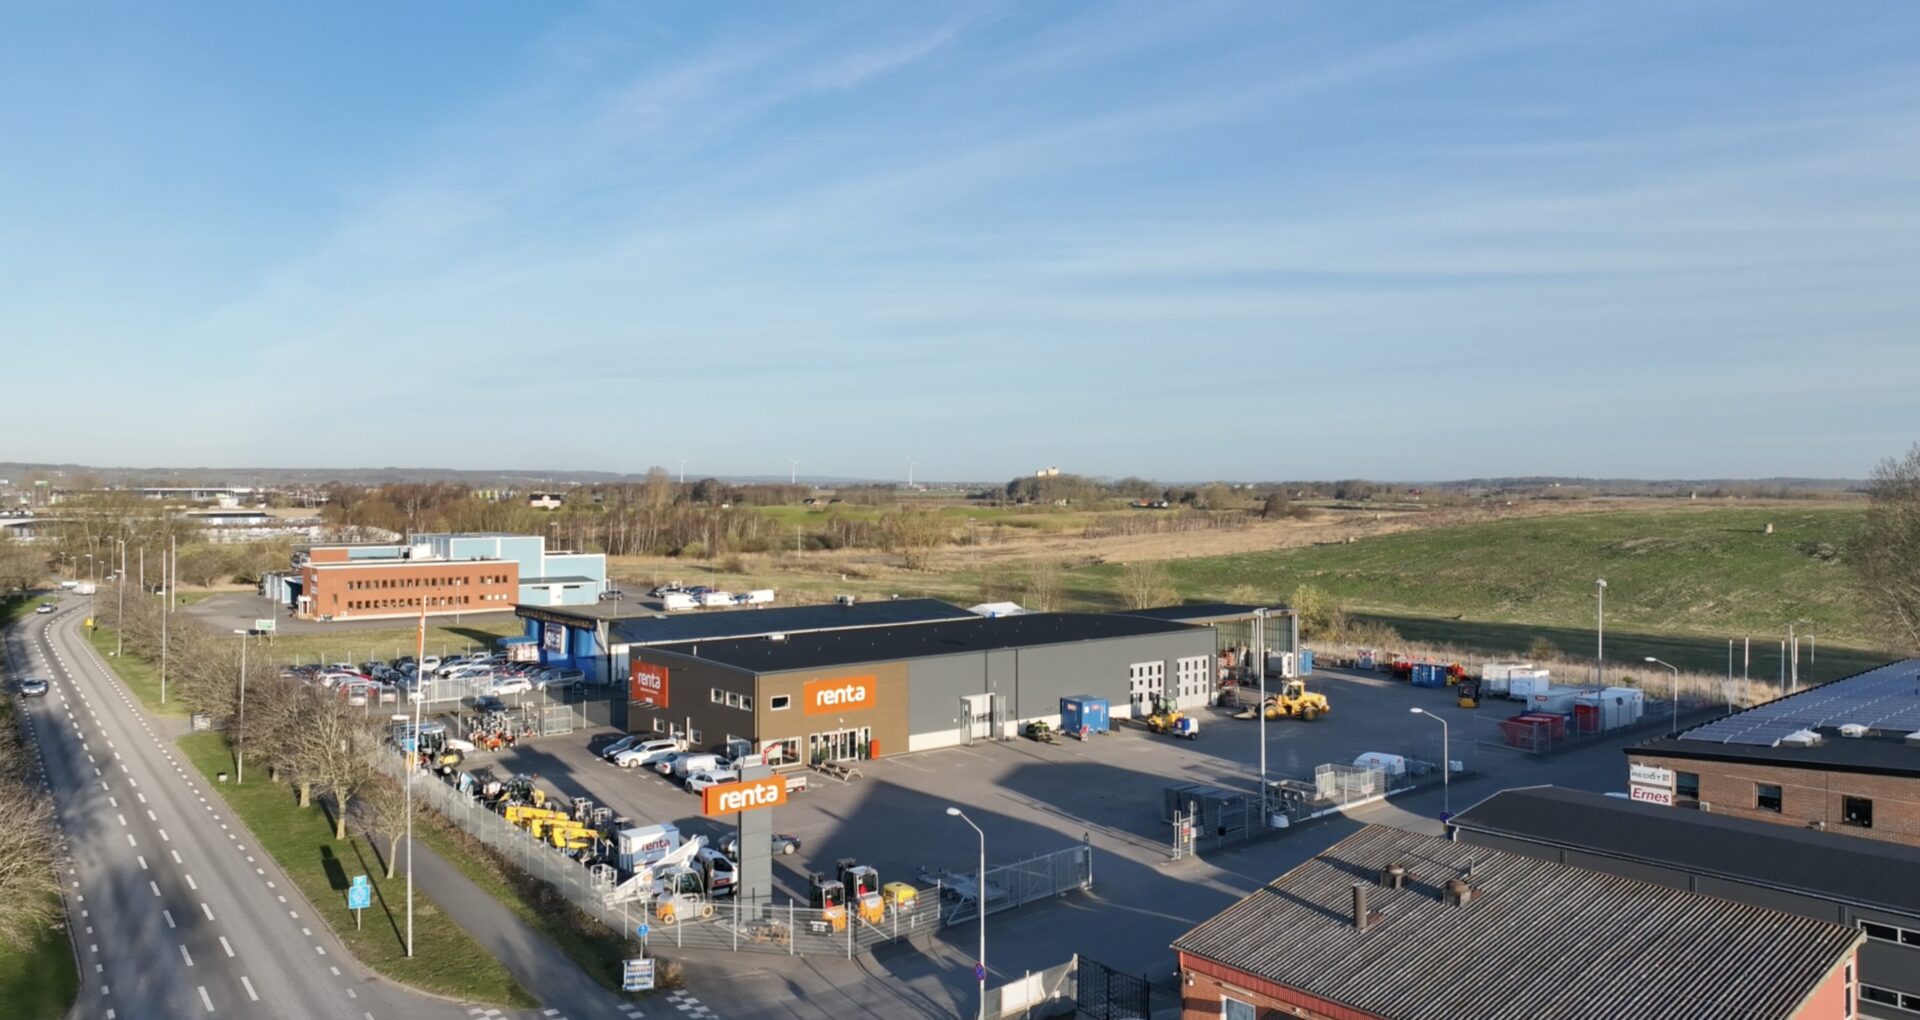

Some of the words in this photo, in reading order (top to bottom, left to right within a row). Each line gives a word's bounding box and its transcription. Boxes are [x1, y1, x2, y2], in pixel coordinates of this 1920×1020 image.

[638, 672, 661, 690] renta
[816, 684, 866, 706] renta
[719, 782, 779, 811] renta
[1632, 787, 1670, 804] Ernes
